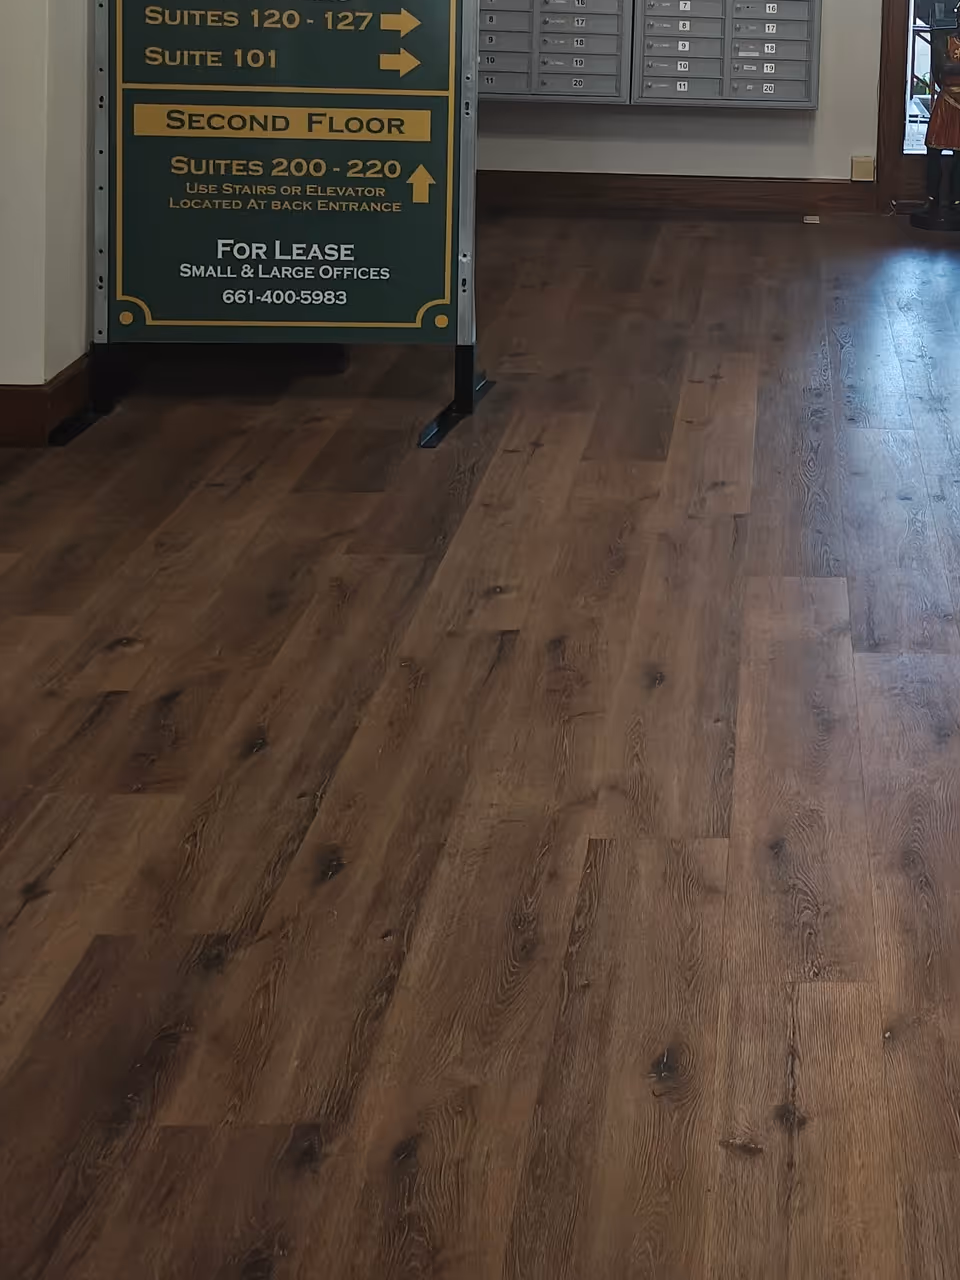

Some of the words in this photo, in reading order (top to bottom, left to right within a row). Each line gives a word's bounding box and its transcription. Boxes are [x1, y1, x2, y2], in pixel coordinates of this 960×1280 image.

[682, 1, 688, 9] 7
[767, 4, 777, 13] 16
[145, 6, 239, 27] SUITES
[251, 9, 299, 29] 120
[325, 11, 372, 30] 127
[488, 15, 494, 24] 8
[575, 18, 586, 26] 17
[681, 21, 688, 30] 8
[766, 24, 776, 32] 17
[487, 35, 494, 44] 9
[574, 38, 585, 47] 18
[680, 42, 687, 50] 9
[765, 44, 775, 53] 18
[145, 47, 222, 66] SUITE
[234, 49, 276, 68] 101
[485, 56, 496, 65] 10
[573, 58, 585, 67] 19
[678, 62, 688, 70] 10
[764, 64, 775, 72] 19
[485, 76, 494, 85] 11
[572, 79, 584, 87] 20
[678, 82, 687, 90] 11
[763, 84, 774, 93] 20
[166, 109, 290, 132] SECOND
[308, 113, 405, 134] FLOOR
[171, 156, 263, 176] SUITES
[271, 158, 326, 177] 200
[347, 159, 401, 178] 220
[186, 183, 218, 194] USE
[222, 183, 276, 195] STAIRS
[280, 185, 301, 196] OR
[307, 185, 385, 197] ELEVATOR
[170, 197, 242, 210] LOCATED
[248, 199, 266, 210] AT
[271, 200, 312, 211] BACK
[318, 200, 401, 212] ENTRANCE
[217, 239, 267, 259] FOR
[275, 240, 354, 260] LEASE
[180, 263, 237, 278] SMALL
[241, 264, 254, 278] &
[259, 265, 314, 279] LARGE
[319, 266, 390, 280] OFFICES
[222, 290, 347, 305] 661-400-5983
